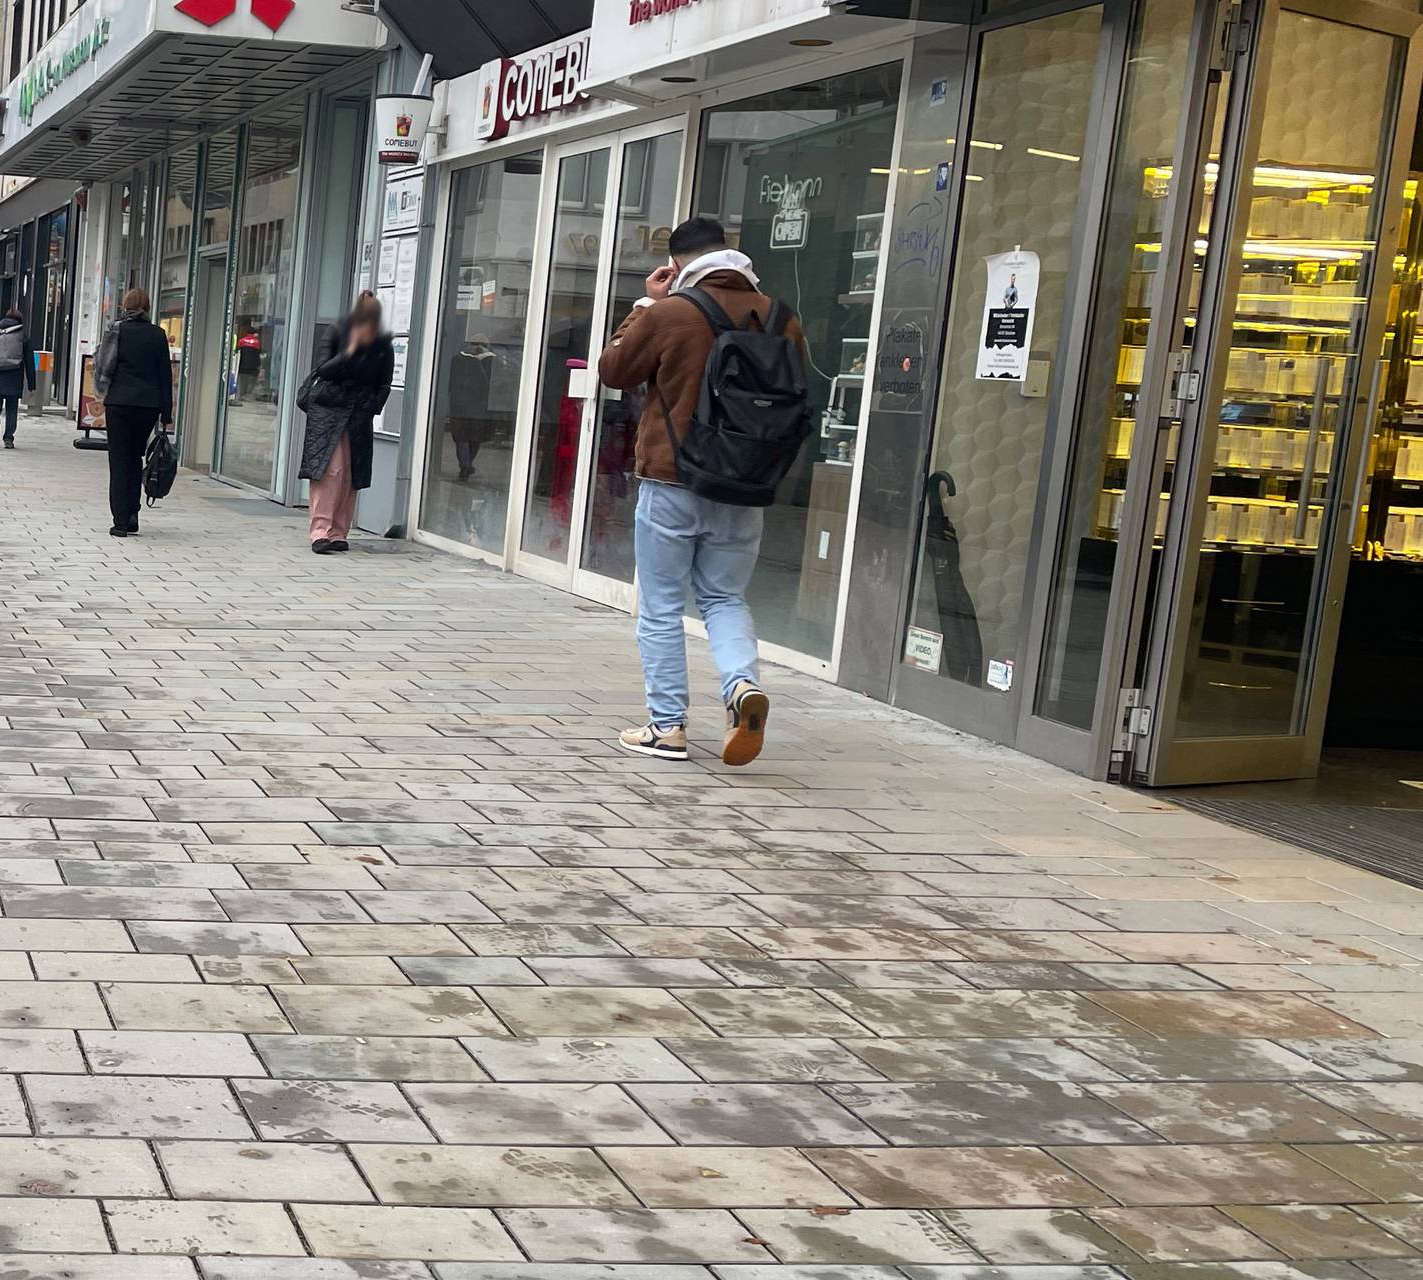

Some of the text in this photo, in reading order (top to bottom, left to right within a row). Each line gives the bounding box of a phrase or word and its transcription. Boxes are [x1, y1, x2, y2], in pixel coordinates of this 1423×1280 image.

[384, 138, 418, 148] COMEBUY
[880, 353, 922, 369] ankleen
[880, 379, 921, 394] verboten
[915, 645, 931, 656] VIDEO
